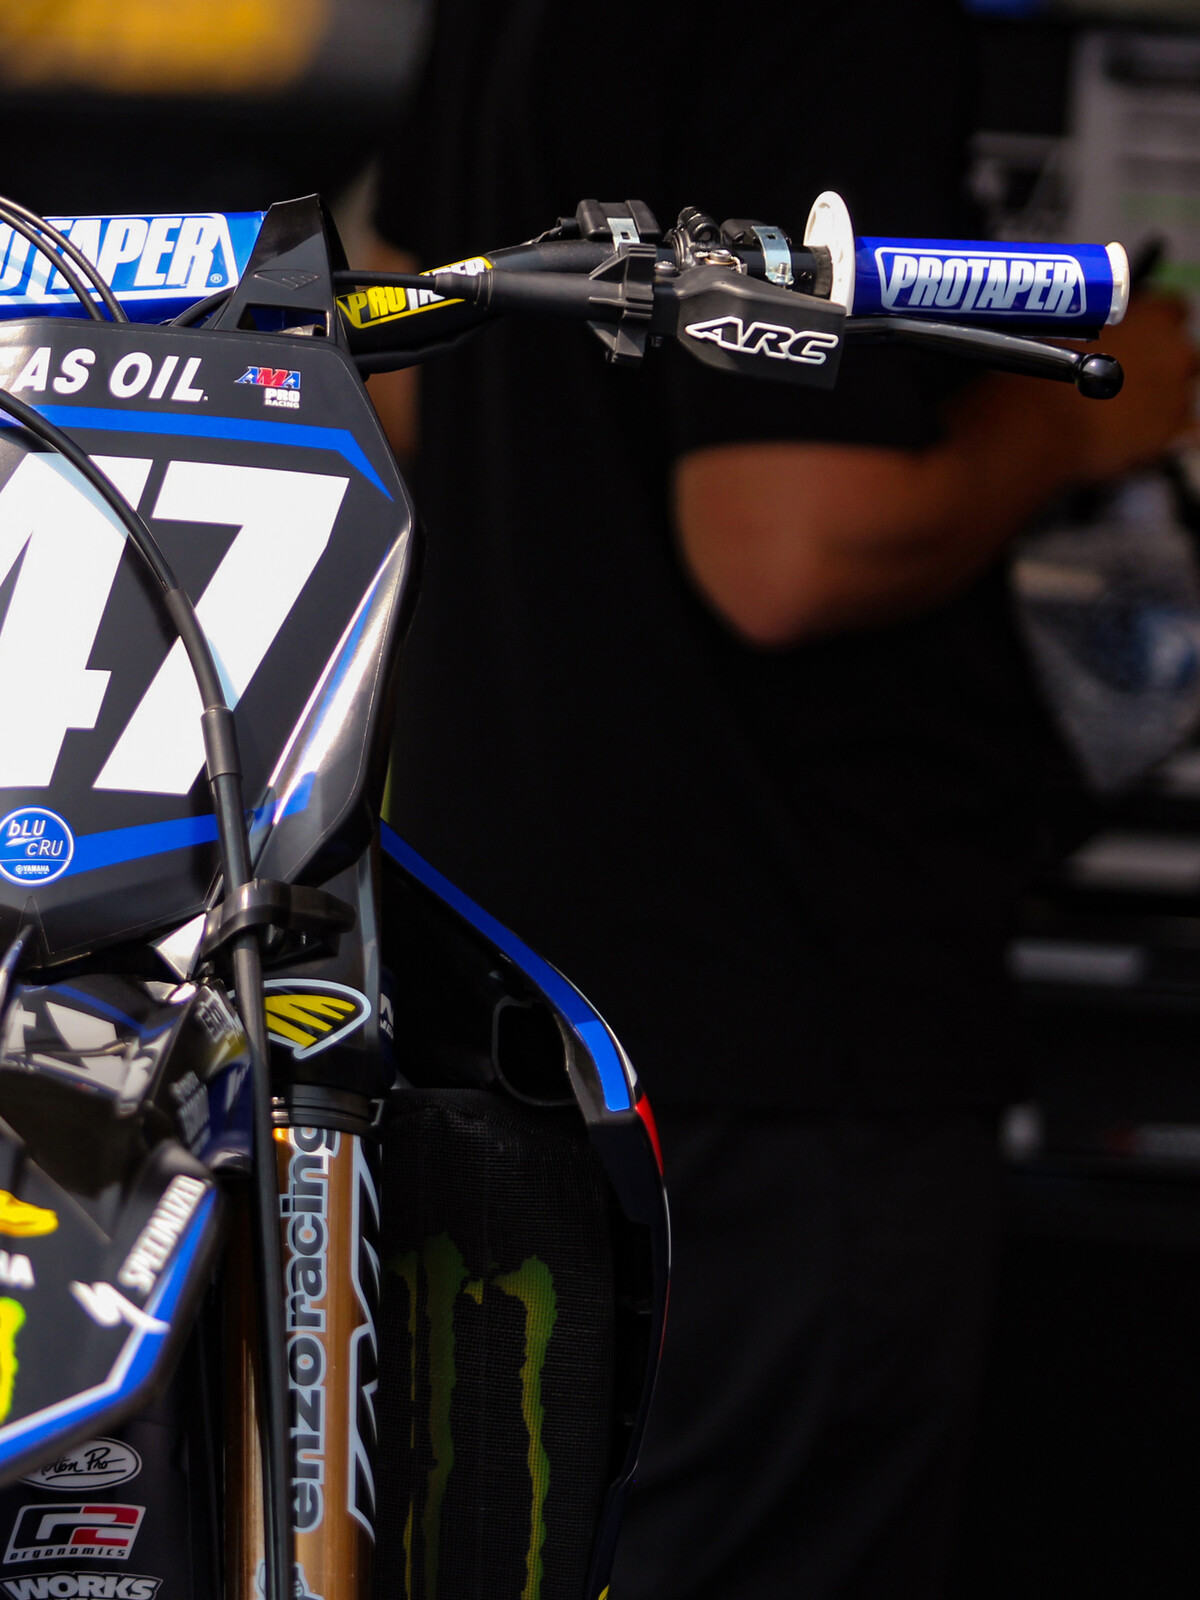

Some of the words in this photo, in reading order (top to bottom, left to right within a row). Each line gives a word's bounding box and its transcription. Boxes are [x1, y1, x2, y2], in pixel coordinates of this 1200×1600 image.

[895, 255, 1078, 315] PROTAPER
[685, 316, 839, 365] ARC
[233, 366, 301, 389] AMA
[265, 387, 301, 402] PRO
[265, 399, 300, 409] RACING
[23, 864, 50, 873] YAMAHA
[9, 1546, 127, 1563] ergonomics
[3, 1574, 158, 1600] WORKS
